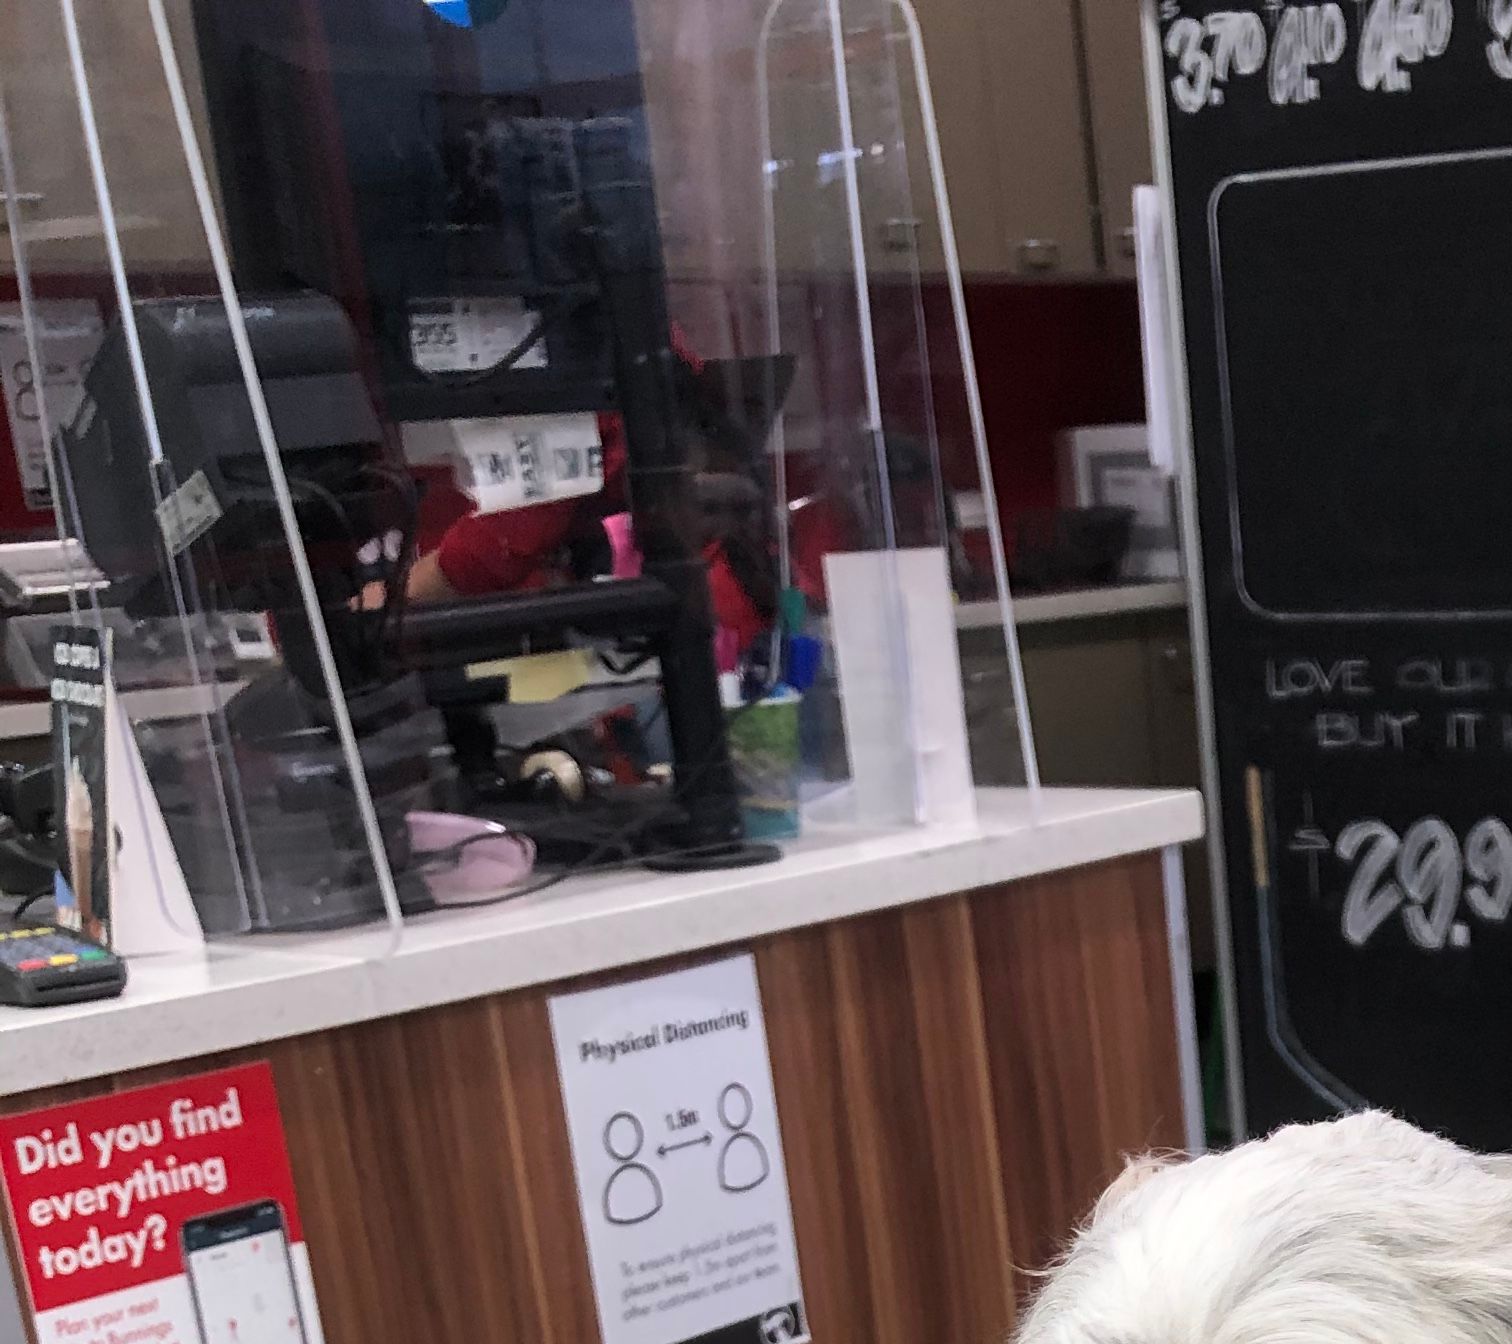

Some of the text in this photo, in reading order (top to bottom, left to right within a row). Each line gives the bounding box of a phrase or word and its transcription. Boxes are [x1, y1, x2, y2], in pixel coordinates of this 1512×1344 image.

[1265, 657, 1374, 698] LOVE
[1313, 711, 1421, 750] BUY
[1446, 710, 1484, 749] IT
[579, 1008, 749, 1064] Physical Distancing
[15, 1086, 243, 1175] Did you find
[28, 1154, 228, 1228] everything
[38, 1212, 168, 1280] today?
